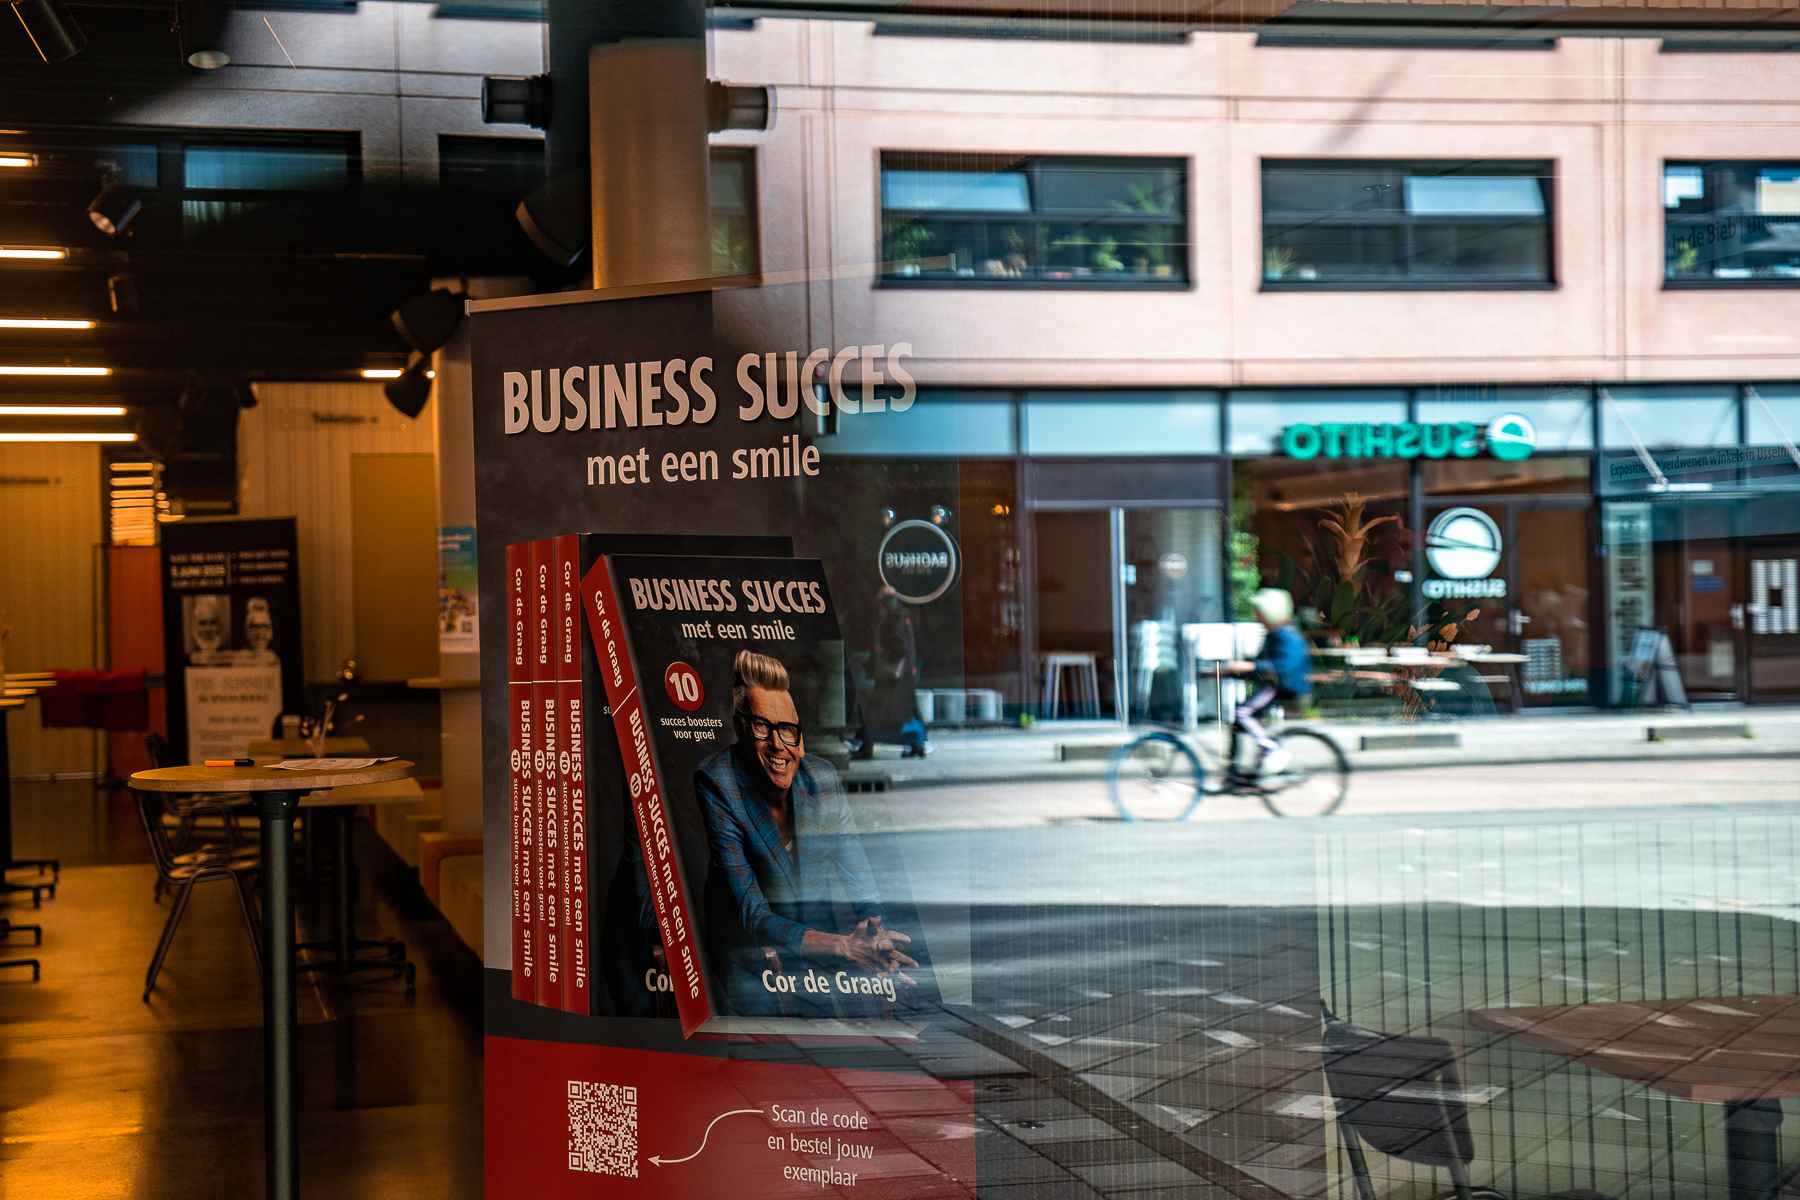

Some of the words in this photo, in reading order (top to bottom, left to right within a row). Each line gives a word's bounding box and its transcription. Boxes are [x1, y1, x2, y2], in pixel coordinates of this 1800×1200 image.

[504, 356, 717, 435] BUSINESS
[736, 342, 917, 421] SUCCES
[587, 448, 650, 486] met
[661, 450, 719, 481] een
[732, 434, 820, 480] smile
[539, 564, 547, 590] Cor
[516, 598, 523, 616] de
[540, 595, 547, 614] de
[565, 592, 573, 611] de
[629, 578, 737, 612] BUSINESS
[742, 580, 826, 614] SUCCES
[540, 619, 548, 664] Graag
[565, 617, 573, 663] Graag
[595, 590, 606, 616] Cor
[602, 619, 611, 639] de
[608, 641, 623, 688] Graag
[682, 621, 713, 639] met
[717, 623, 747, 639] een
[751, 620, 795, 640] smile
[669, 672, 699, 702] 10
[660, 716, 686, 726] succes
[687, 716, 723, 727] boosters
[674, 730, 691, 739] voor
[694, 728, 715, 742] groei
[521, 700, 531, 780] BUSINESS
[545, 700, 556, 780] BUSINESS
[570, 699, 582, 782] BUSINESS
[522, 786, 532, 846] SUCCES
[547, 786, 557, 848] SUCCES
[572, 789, 584, 851] SUCCES
[522, 851, 532, 886] met
[629, 707, 655, 792] BUSINESS
[648, 794, 670, 860] SUCCES
[663, 862, 678, 903] met
[672, 906, 686, 942] een
[681, 945, 699, 999] smile
[548, 853, 556, 889] met
[574, 858, 583, 892] met
[524, 893, 532, 924] een
[548, 894, 556, 928] een
[575, 899, 583, 932] een
[524, 929, 533, 977] smile
[549, 934, 560, 984] smile
[575, 938, 586, 989] smile
[762, 969, 796, 994] Cor
[804, 970, 830, 992] de
[836, 971, 896, 1003] Graag
[772, 1105, 806, 1125] Scan
[811, 1105, 828, 1127] de
[833, 1111, 868, 1131] code
[767, 1135, 785, 1151] en
[790, 1134, 832, 1156] bestel
[836, 1140, 874, 1161] jouw
[783, 1165, 858, 1188] exemplaar
